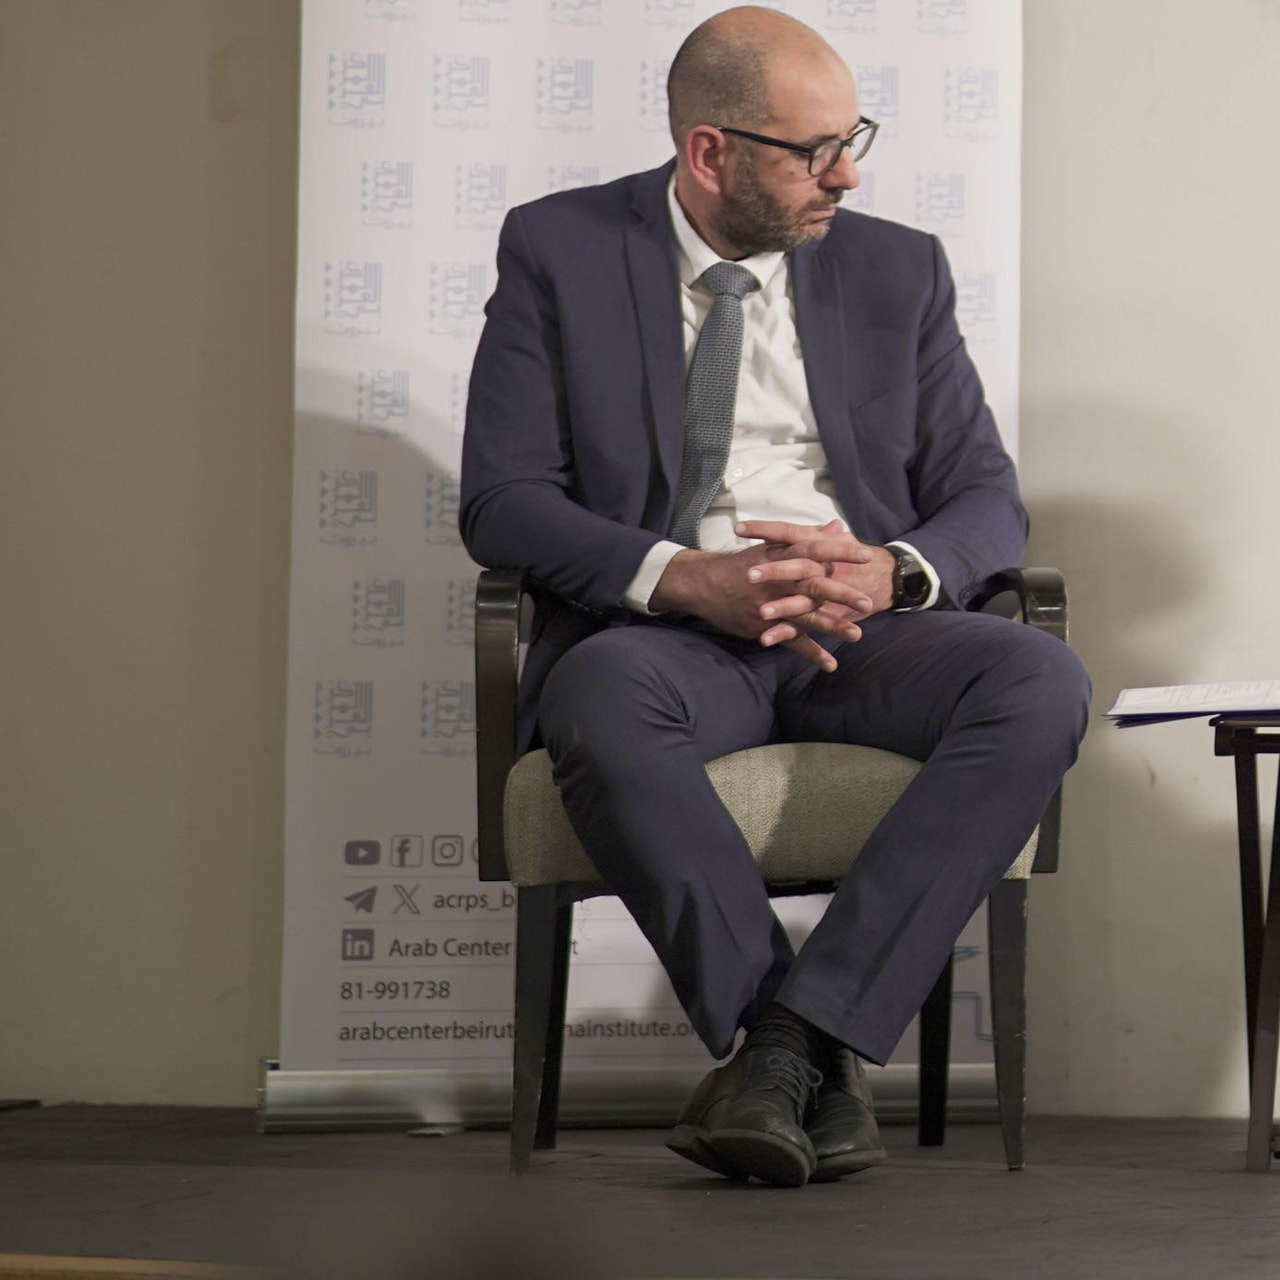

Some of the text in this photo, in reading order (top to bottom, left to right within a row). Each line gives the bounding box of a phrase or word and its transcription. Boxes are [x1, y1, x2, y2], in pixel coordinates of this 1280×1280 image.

[433, 888, 515, 911] acrps_b
[388, 938, 511, 957] Arab Center
[339, 980, 451, 1001] 81-991738
